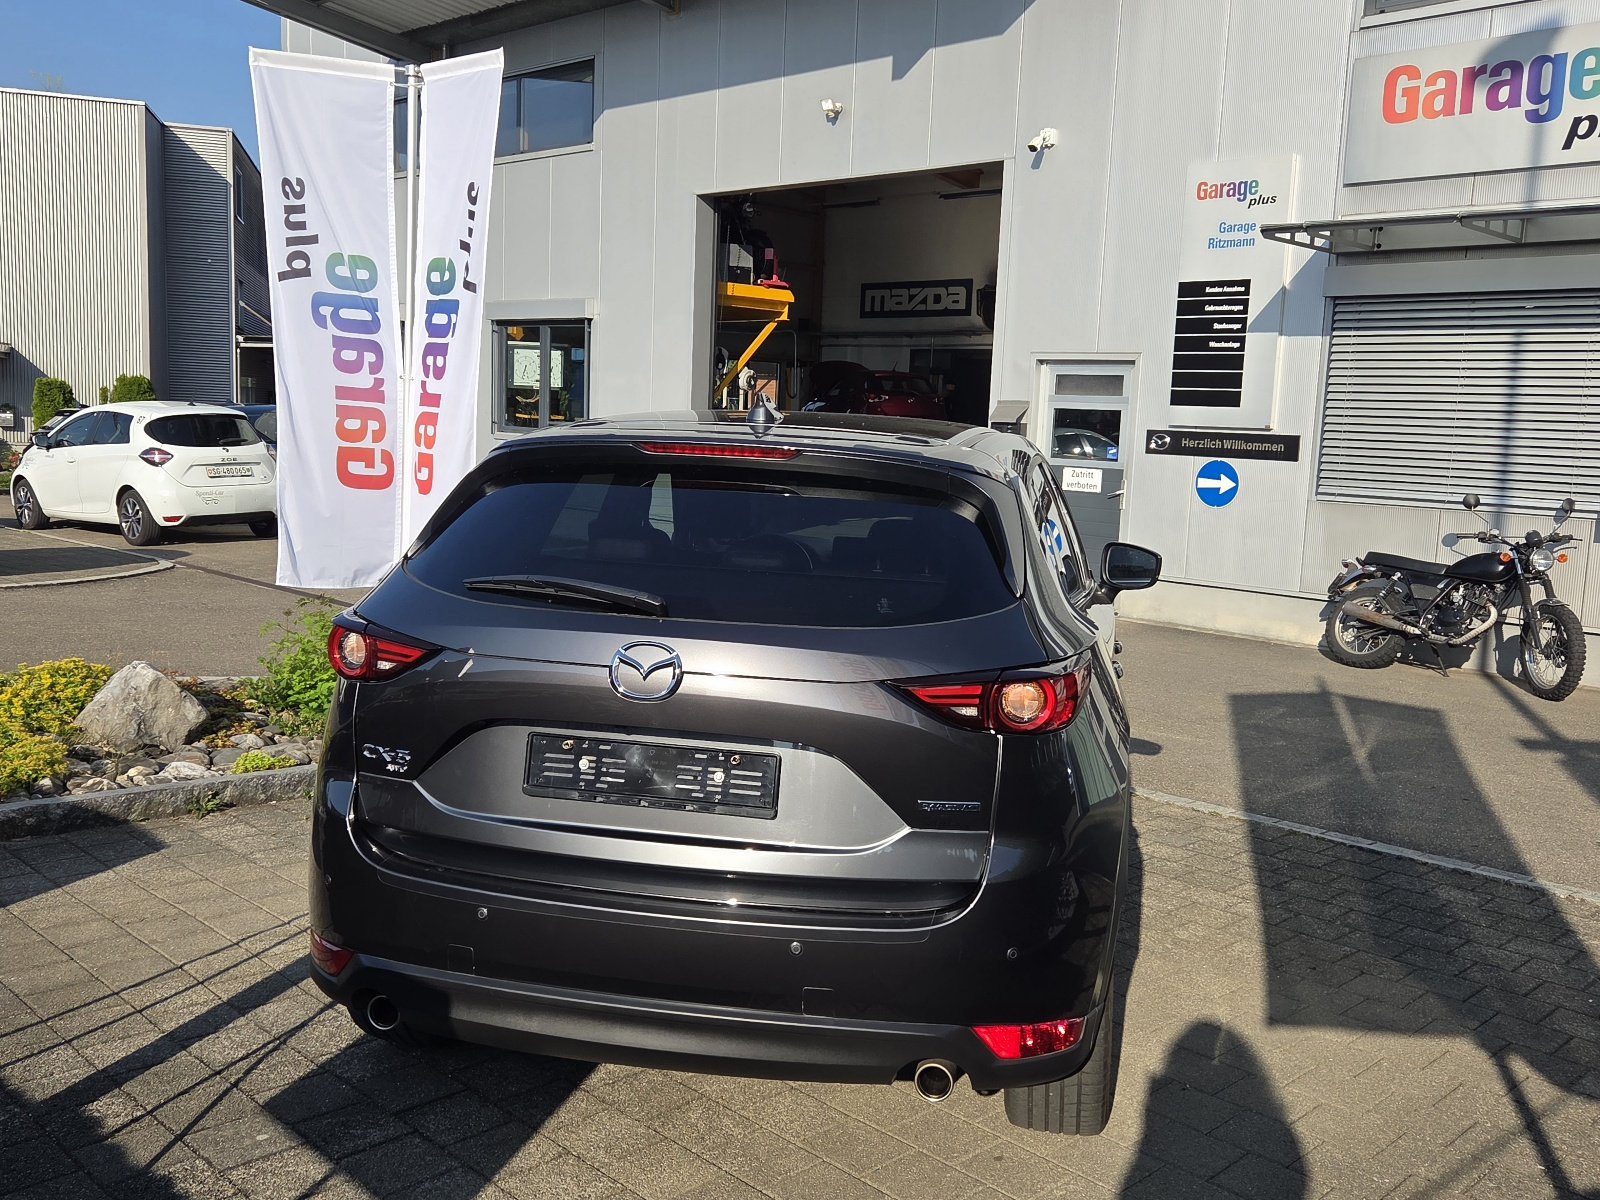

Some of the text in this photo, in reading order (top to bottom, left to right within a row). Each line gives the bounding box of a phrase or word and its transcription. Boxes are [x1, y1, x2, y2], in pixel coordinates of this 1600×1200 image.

[1382, 47, 1600, 125] Garage
[1196, 179, 1259, 202] Garage
[1247, 194, 1277, 209] plus
[1219, 221, 1257, 234] Garage
[1207, 237, 1255, 249] Ritzmann
[414, 256, 460, 496] Garage
[1181, 437, 1285, 452] Herzlich Willkommen
[1071, 469, 1095, 479] Zutritt
[1066, 481, 1098, 490] verboten
